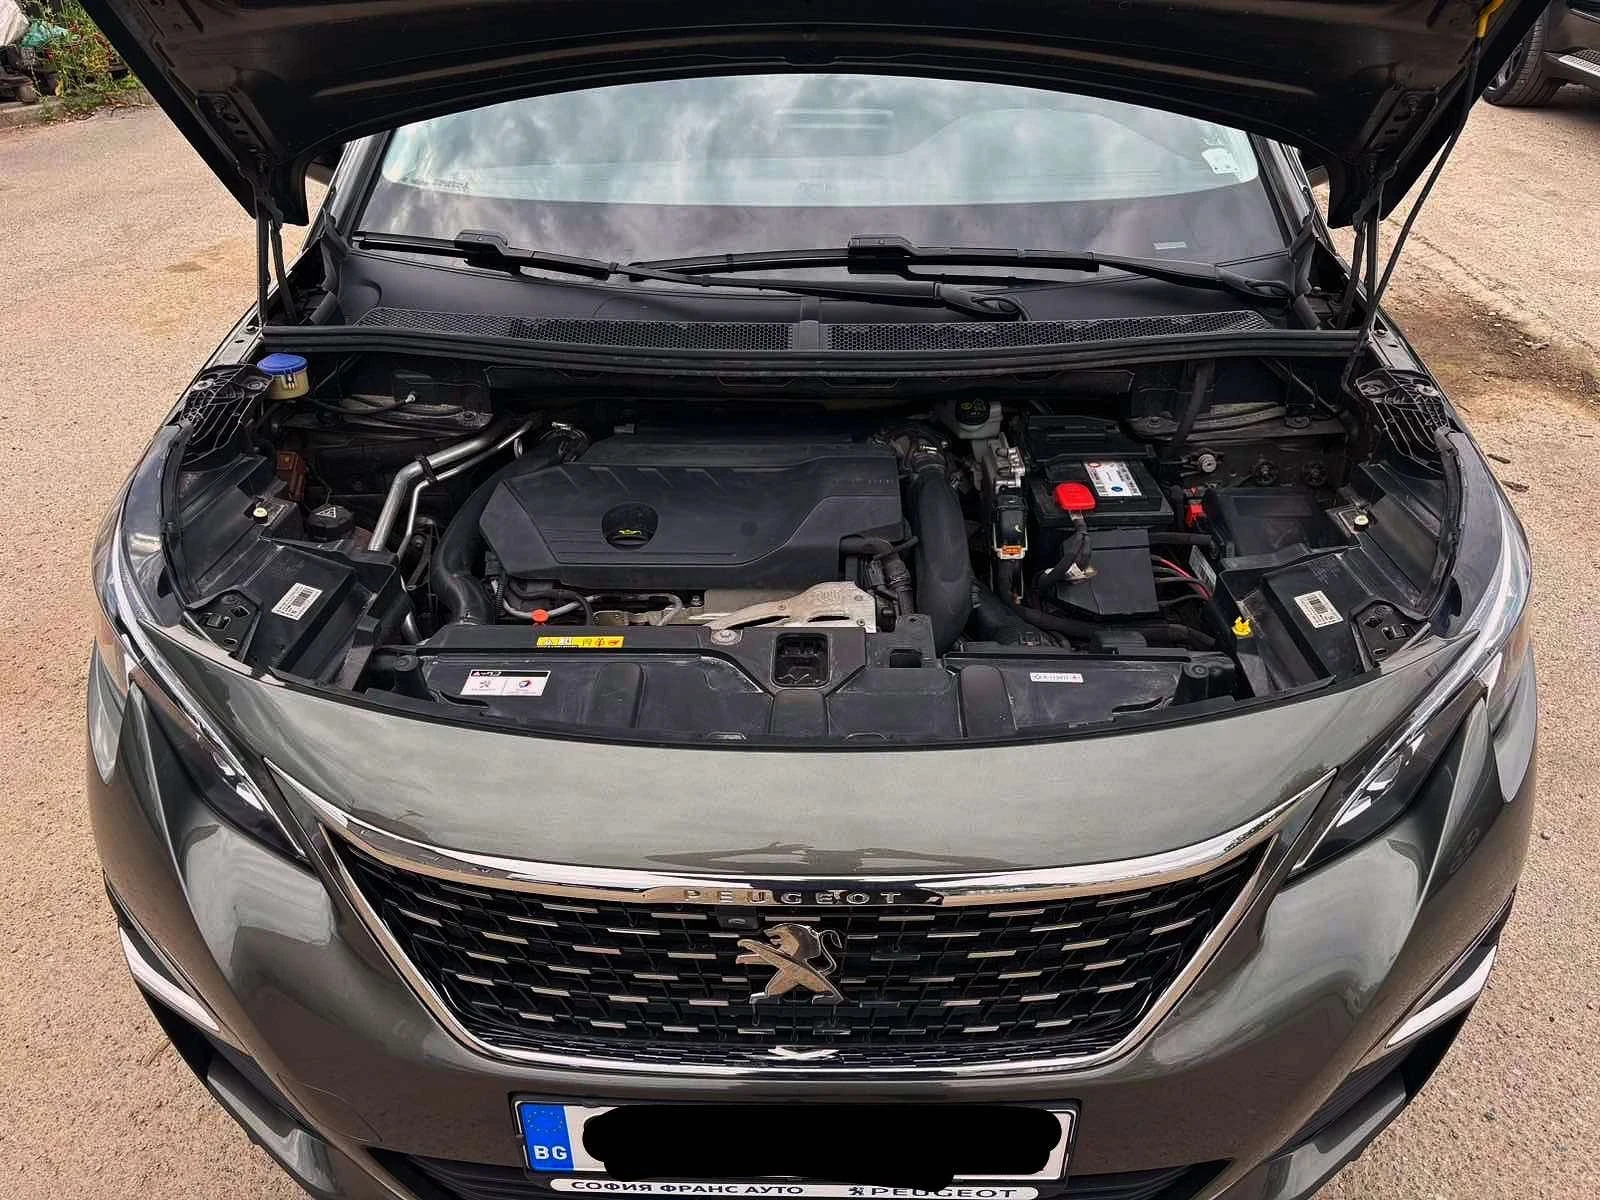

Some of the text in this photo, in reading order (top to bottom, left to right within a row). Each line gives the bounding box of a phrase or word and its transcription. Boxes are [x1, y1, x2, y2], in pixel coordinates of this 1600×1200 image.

[684, 889, 902, 905] PEUGEOT
[533, 1144, 568, 1161] BG
[571, 1180, 805, 1195] СОФИЯ ФРАНС АУТО
